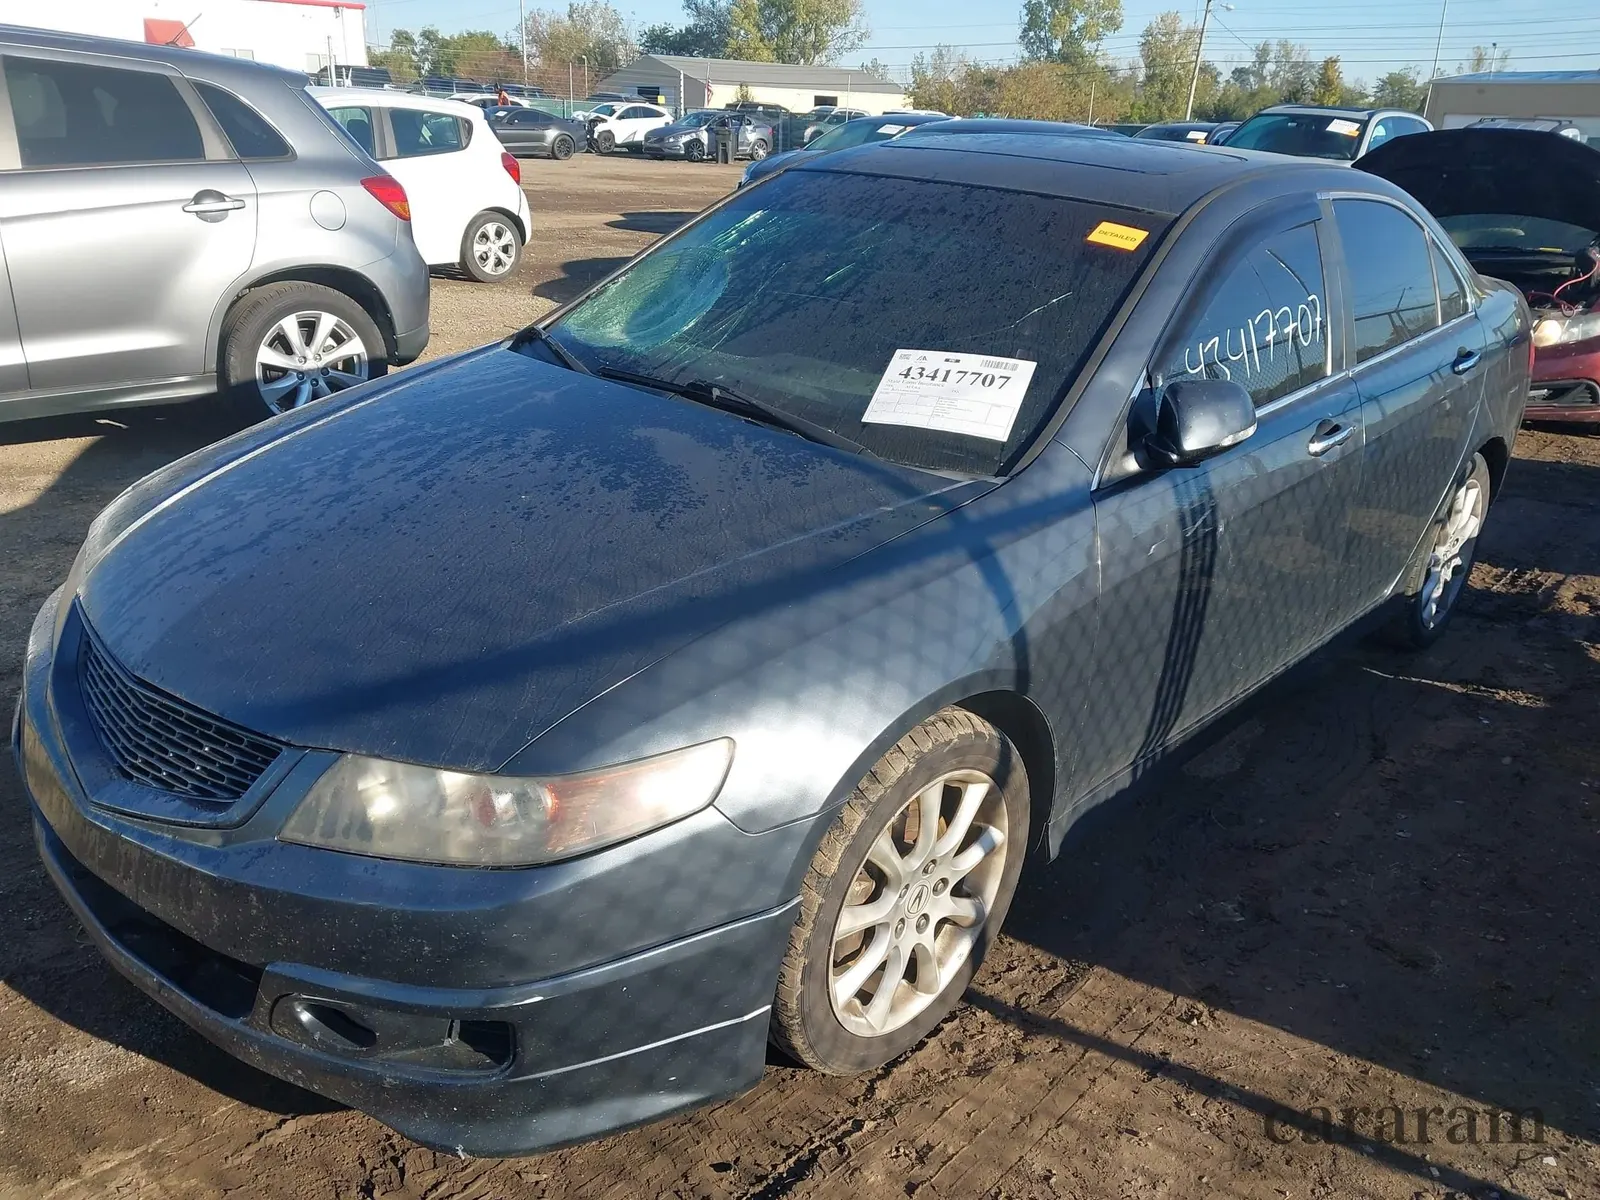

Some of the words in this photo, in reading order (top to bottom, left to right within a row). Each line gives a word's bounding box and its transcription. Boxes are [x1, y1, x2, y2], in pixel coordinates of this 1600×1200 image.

[1098, 229, 1137, 242] DETAILED
[1184, 294, 1322, 381] 43417707
[898, 365, 1012, 390] 43417707
